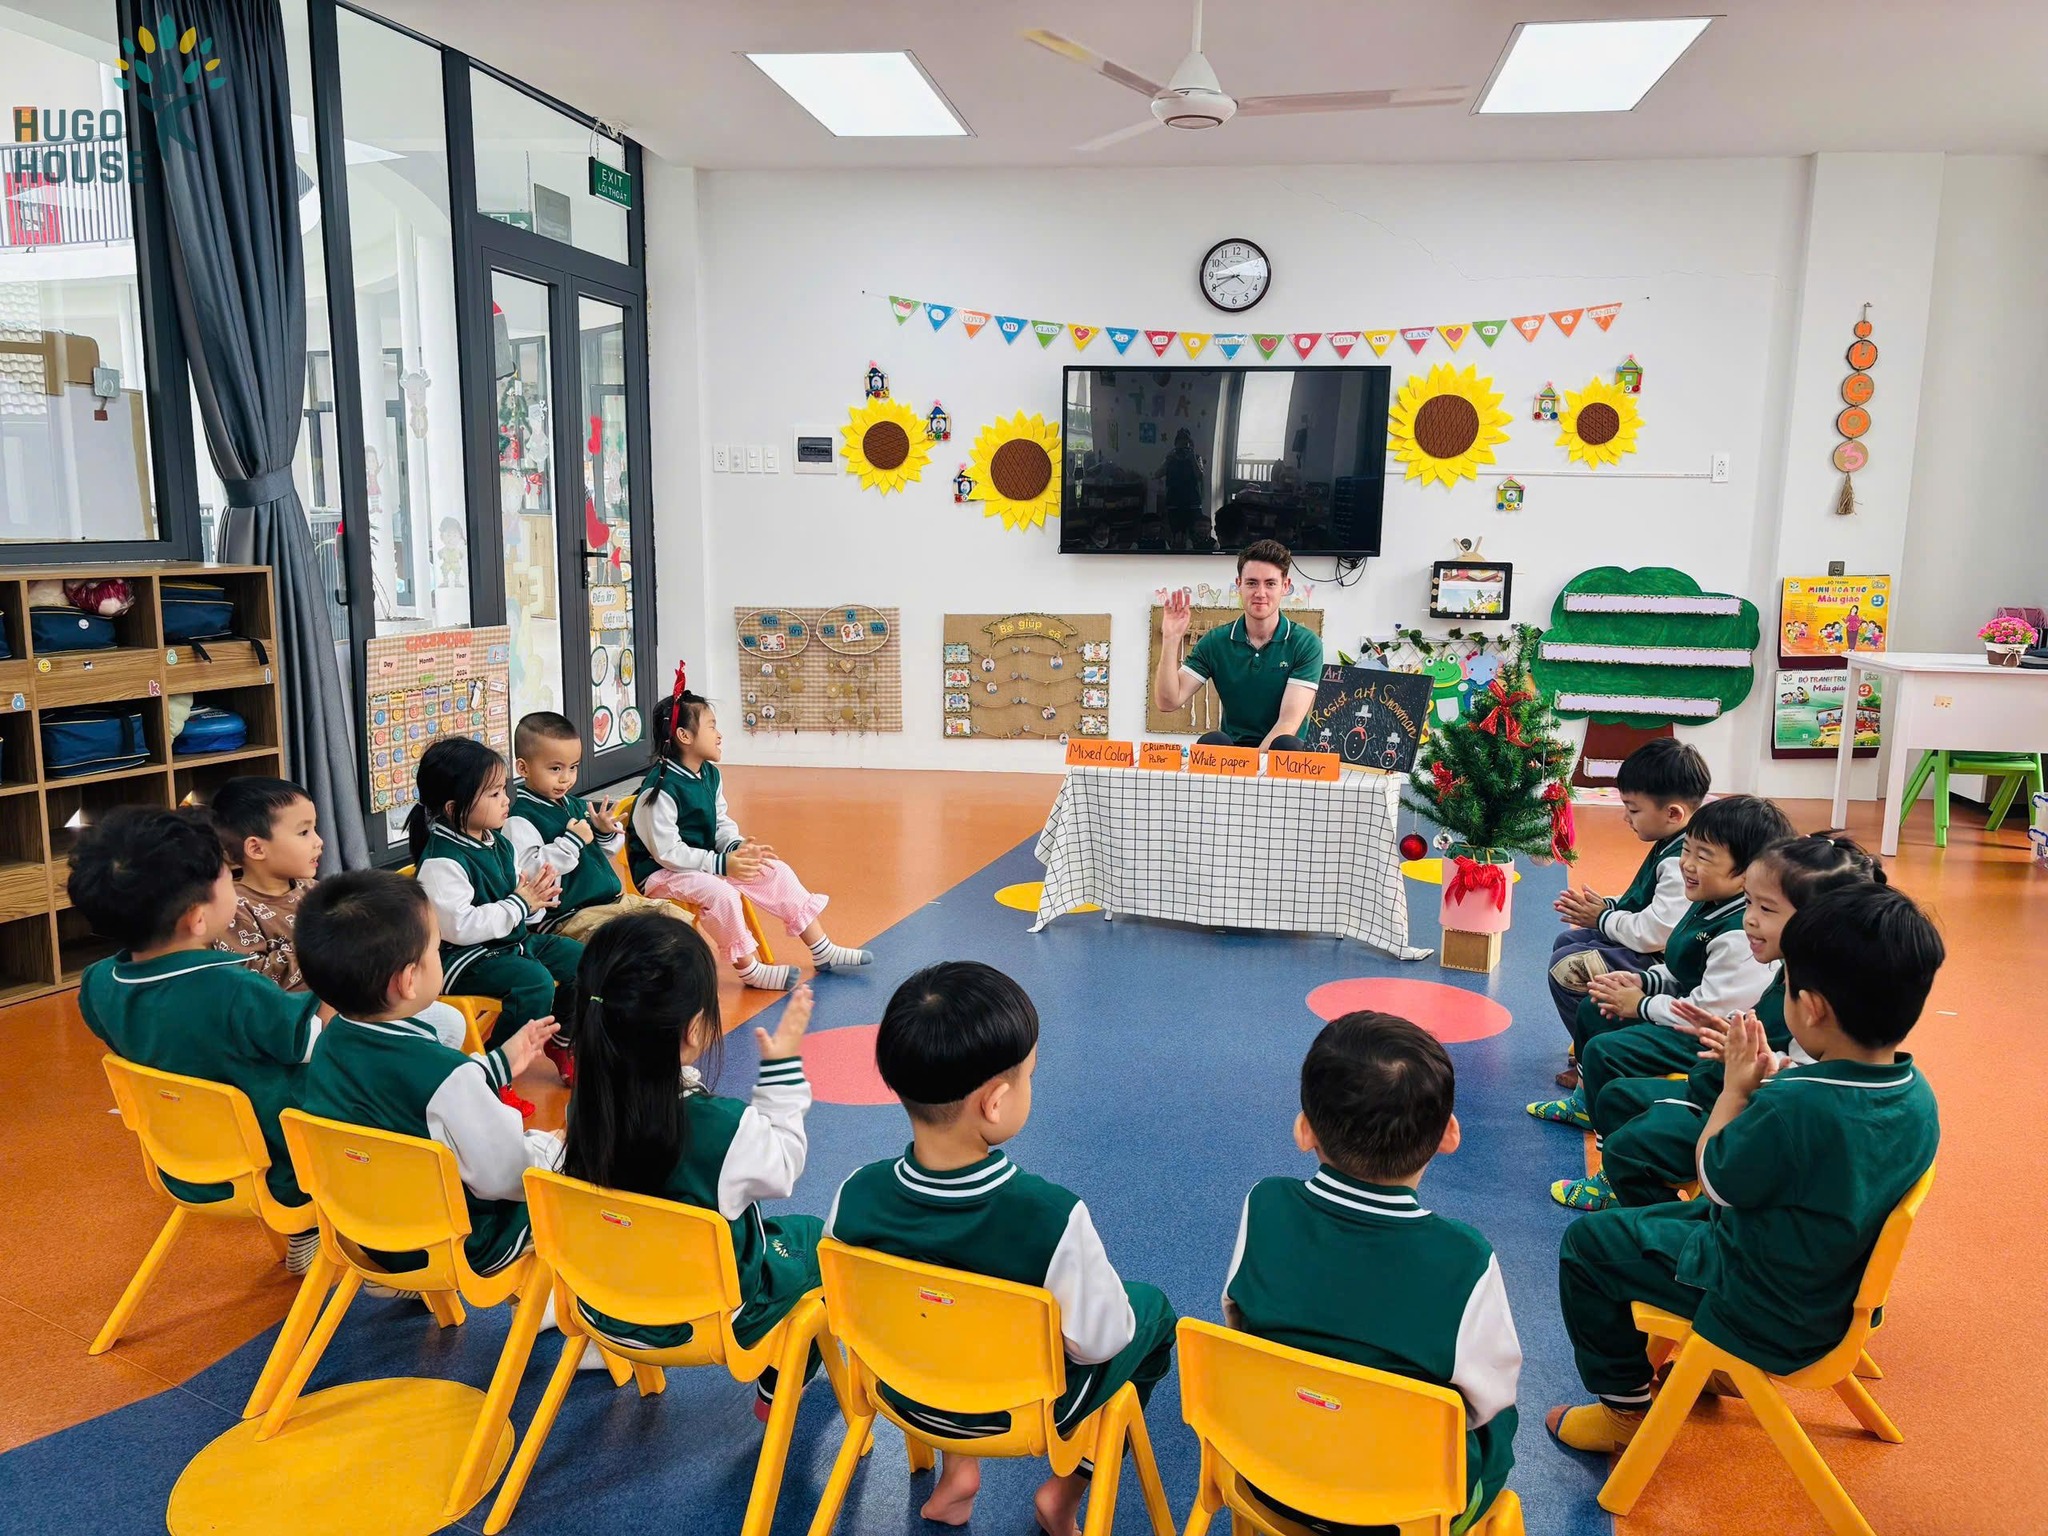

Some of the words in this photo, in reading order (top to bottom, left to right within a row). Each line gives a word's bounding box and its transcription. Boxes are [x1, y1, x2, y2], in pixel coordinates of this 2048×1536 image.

[601, 169, 623, 187] EXIT
[963, 315, 984, 324] LOVE
[1005, 323, 1017, 331] MY
[1036, 325, 1058, 334] CLASS
[1334, 336, 1355, 345] LOVE
[1405, 330, 1431, 339] CLASS
[761, 615, 779, 626] đến
[788, 624, 803, 637] lớp
[38, 658, 52, 673] e
[383, 660, 394, 669] Day
[418, 656, 435, 665] Month
[455, 652, 468, 660] Year
[1323, 666, 1344, 681] Art
[148, 679, 161, 697] k
[1309, 689, 1349, 729] Resist
[1353, 681, 1377, 701] art
[1378, 683, 1420, 740] Snowman
[1068, 742, 1102, 762] Mixed
[1104, 745, 1133, 763] Color
[1190, 749, 1217, 767] White
[1220, 756, 1251, 774] paper
